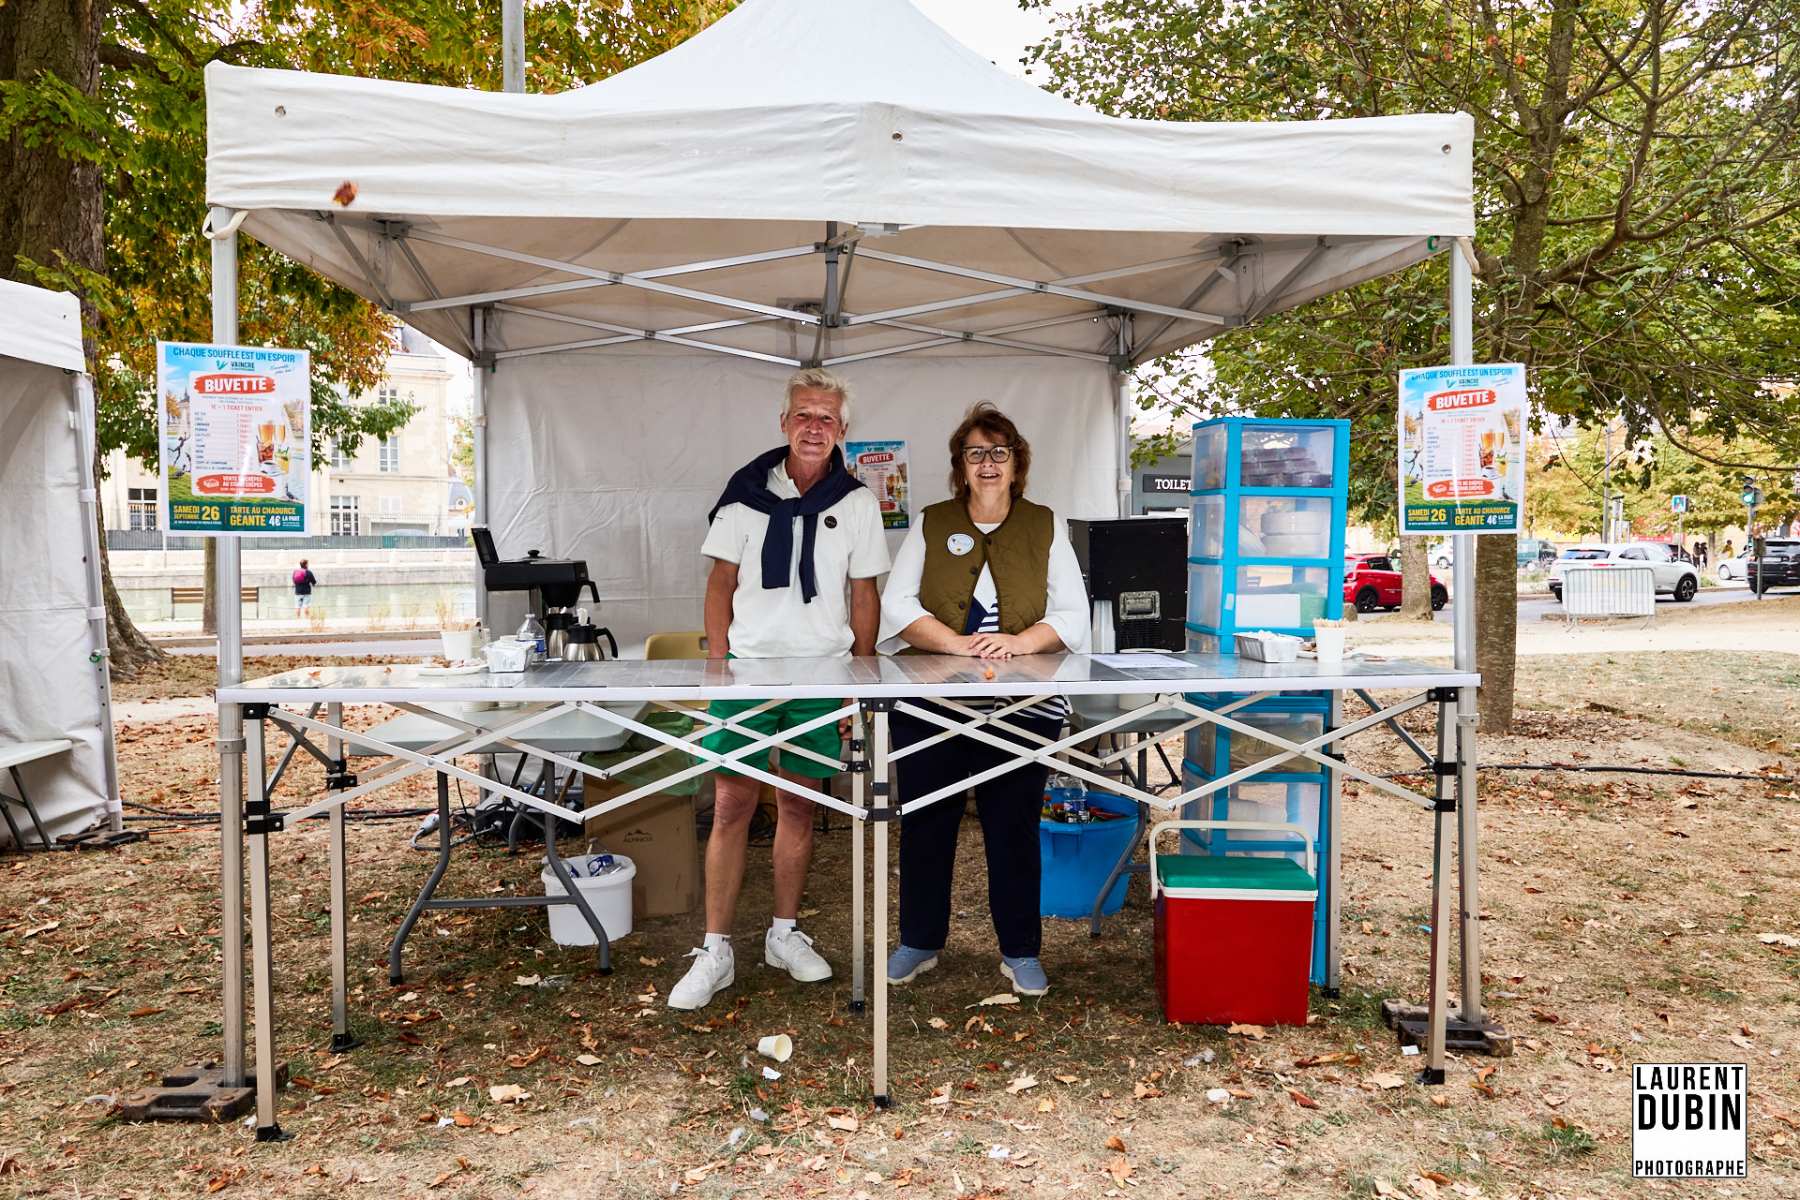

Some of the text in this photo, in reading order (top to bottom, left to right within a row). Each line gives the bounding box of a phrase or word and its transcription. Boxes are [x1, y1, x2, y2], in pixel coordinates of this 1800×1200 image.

[172, 346, 296, 363] CHAQUE SOUFFLE EST UN ESPOIR
[1439, 368, 1467, 378] SOUFFLE
[1467, 368, 1479, 377] EST
[1479, 368, 1489, 376] UN
[1489, 367, 1513, 376] ESPOIR
[204, 377, 267, 393] BUVETTE
[1435, 390, 1489, 409] BUVETTE
[862, 453, 891, 464] BUVETTE
[173, 505, 200, 513] SAMEDI
[201, 505, 220, 521] 26
[230, 506, 250, 514] TARTE
[251, 506, 261, 514] AU
[1407, 508, 1430, 516] SAMEDI
[1430, 508, 1446, 521] 26
[230, 514, 266, 527] GÉANTE
[268, 515, 281, 526] 4€
[1486, 514, 1497, 525] 4€
